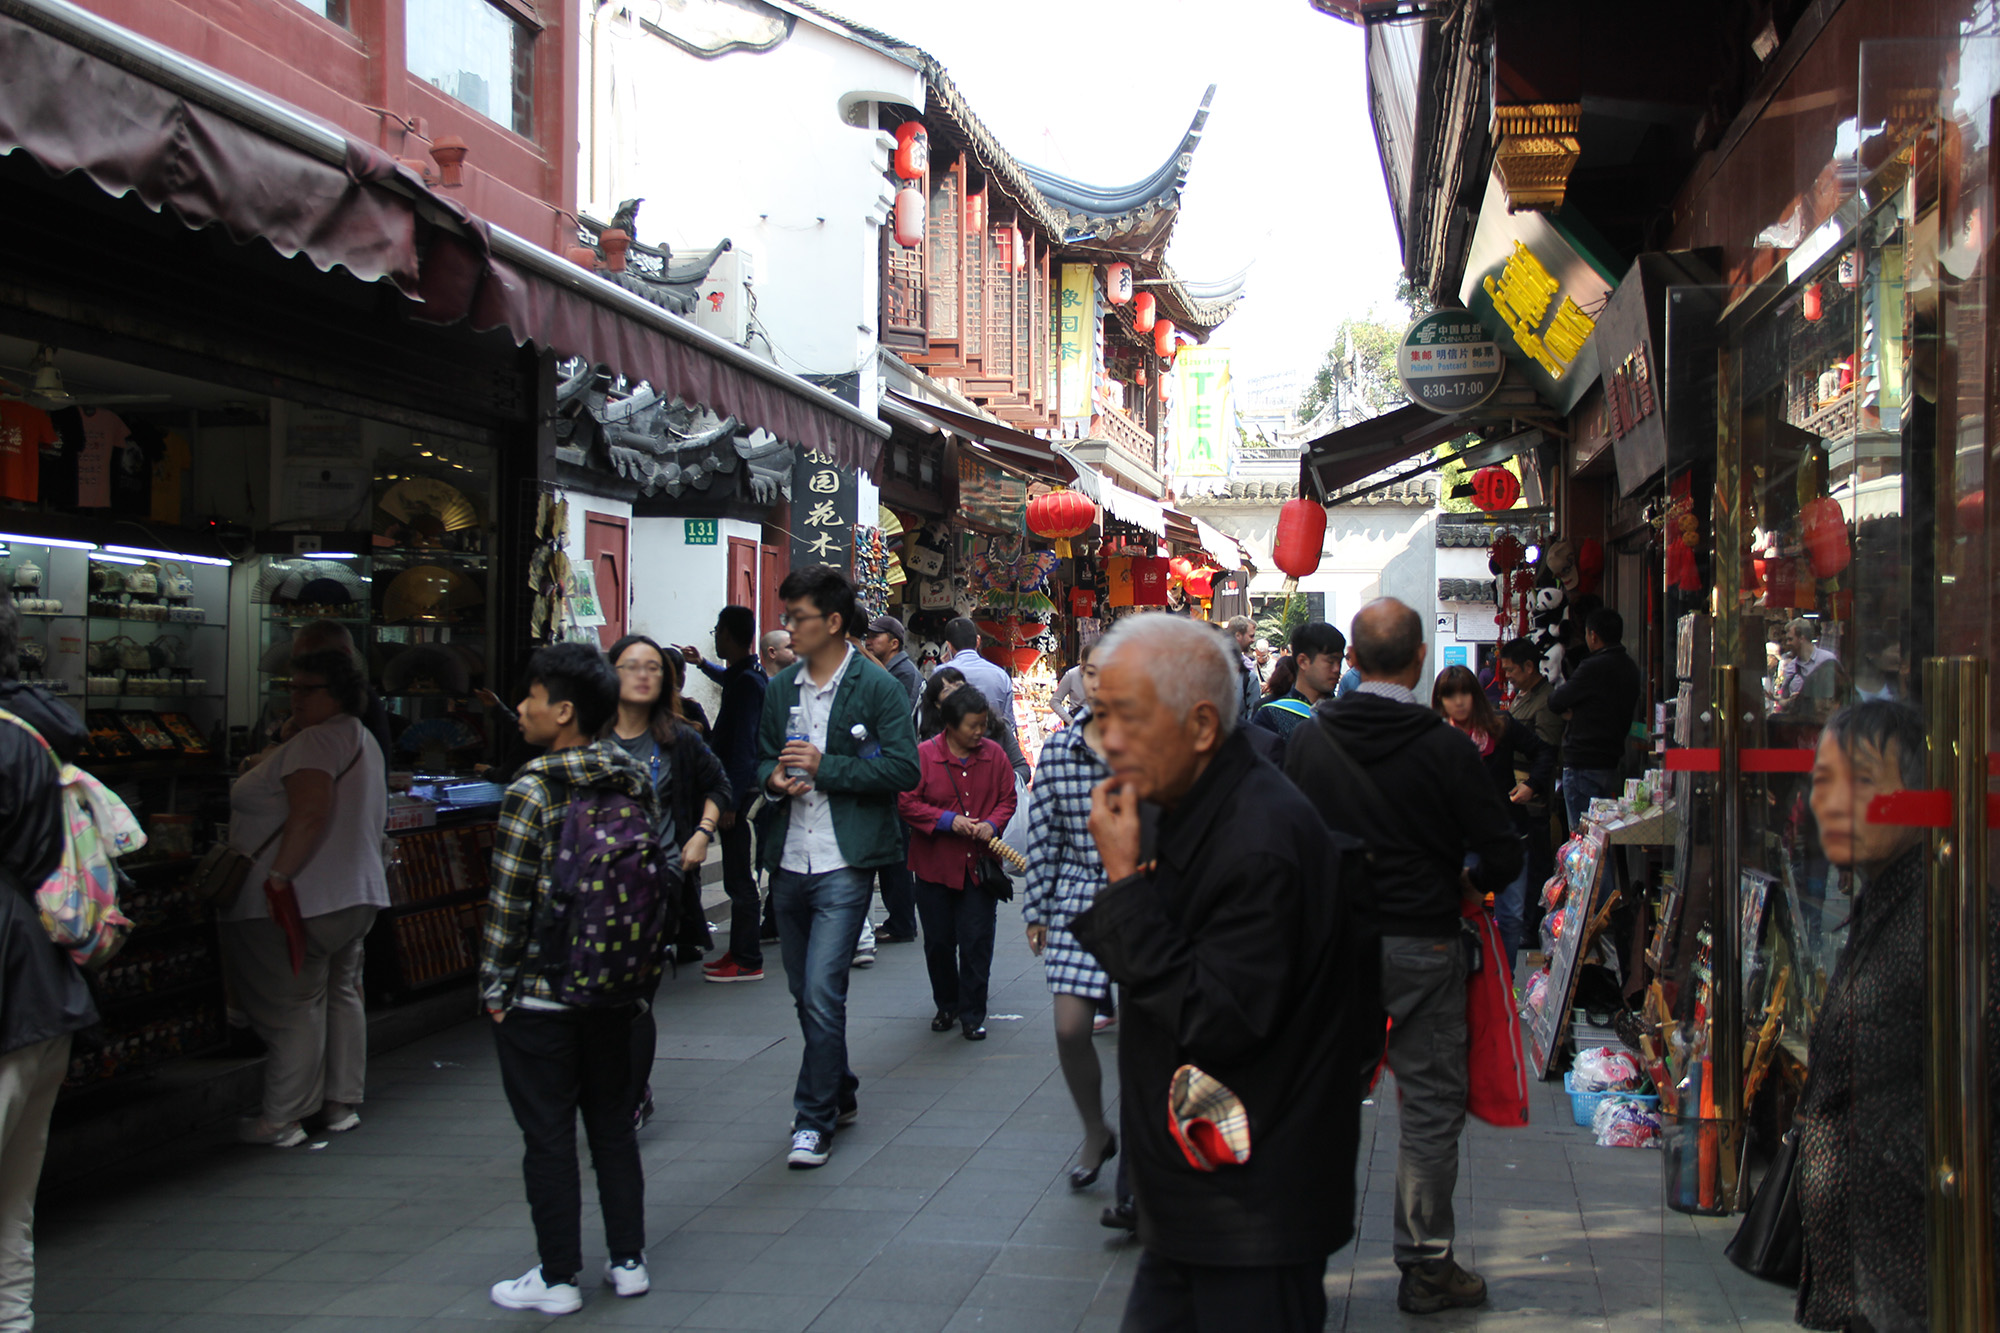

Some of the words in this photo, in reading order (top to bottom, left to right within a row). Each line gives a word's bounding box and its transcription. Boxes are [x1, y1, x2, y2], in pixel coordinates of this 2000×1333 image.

[1438, 323, 1482, 335] 中国邮政
[1410, 350, 1432, 361] 集邮
[1436, 348, 1468, 360] 明信片
[1472, 346, 1494, 358] 邮票
[1410, 364, 1433, 373] Philately
[1438, 362, 1467, 371] Postcard
[1472, 360, 1495, 368] Stamps
[1423, 381, 1484, 398] 8:30-17:00
[1188, 372, 1215, 460] TEA
[804, 447, 844, 568] 园花木
[688, 522, 715, 536] 131
